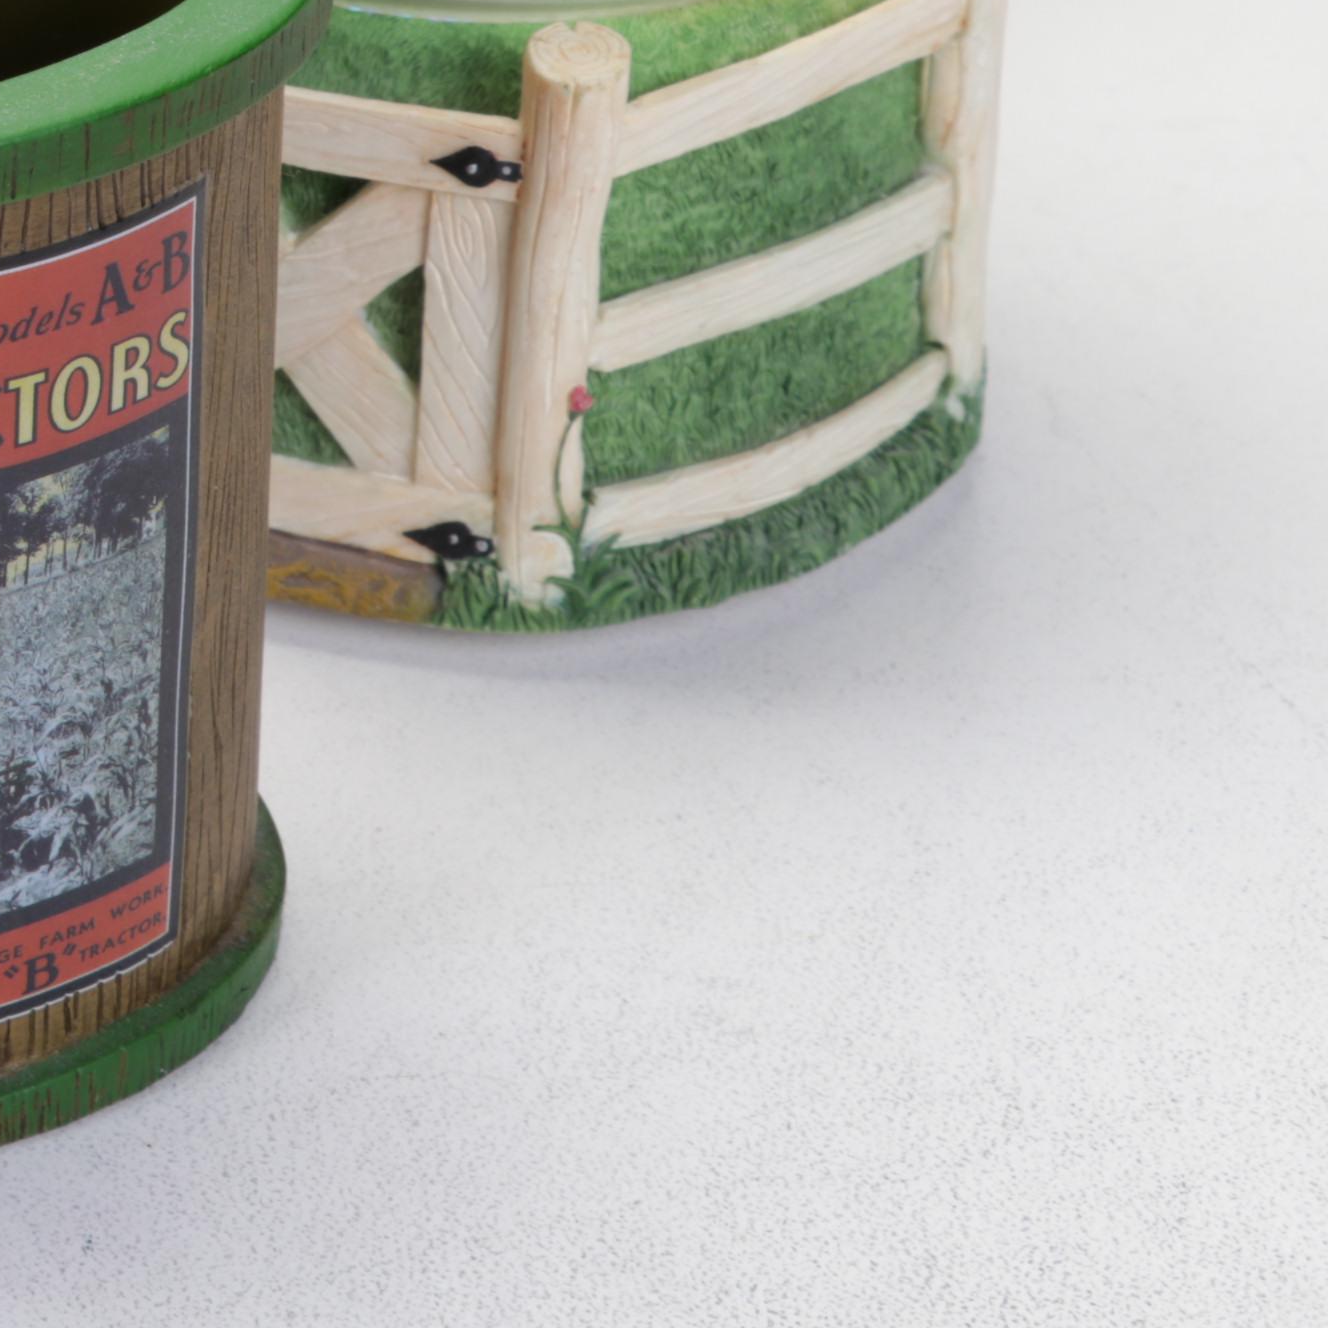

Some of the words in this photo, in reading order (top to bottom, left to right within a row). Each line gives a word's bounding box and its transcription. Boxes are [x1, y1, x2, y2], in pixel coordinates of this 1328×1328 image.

[91, 230, 191, 325] A&B
[38, 918, 97, 951] FARM
[109, 881, 169, 921] WORK.
[78, 911, 168, 964] TRACTOR.
